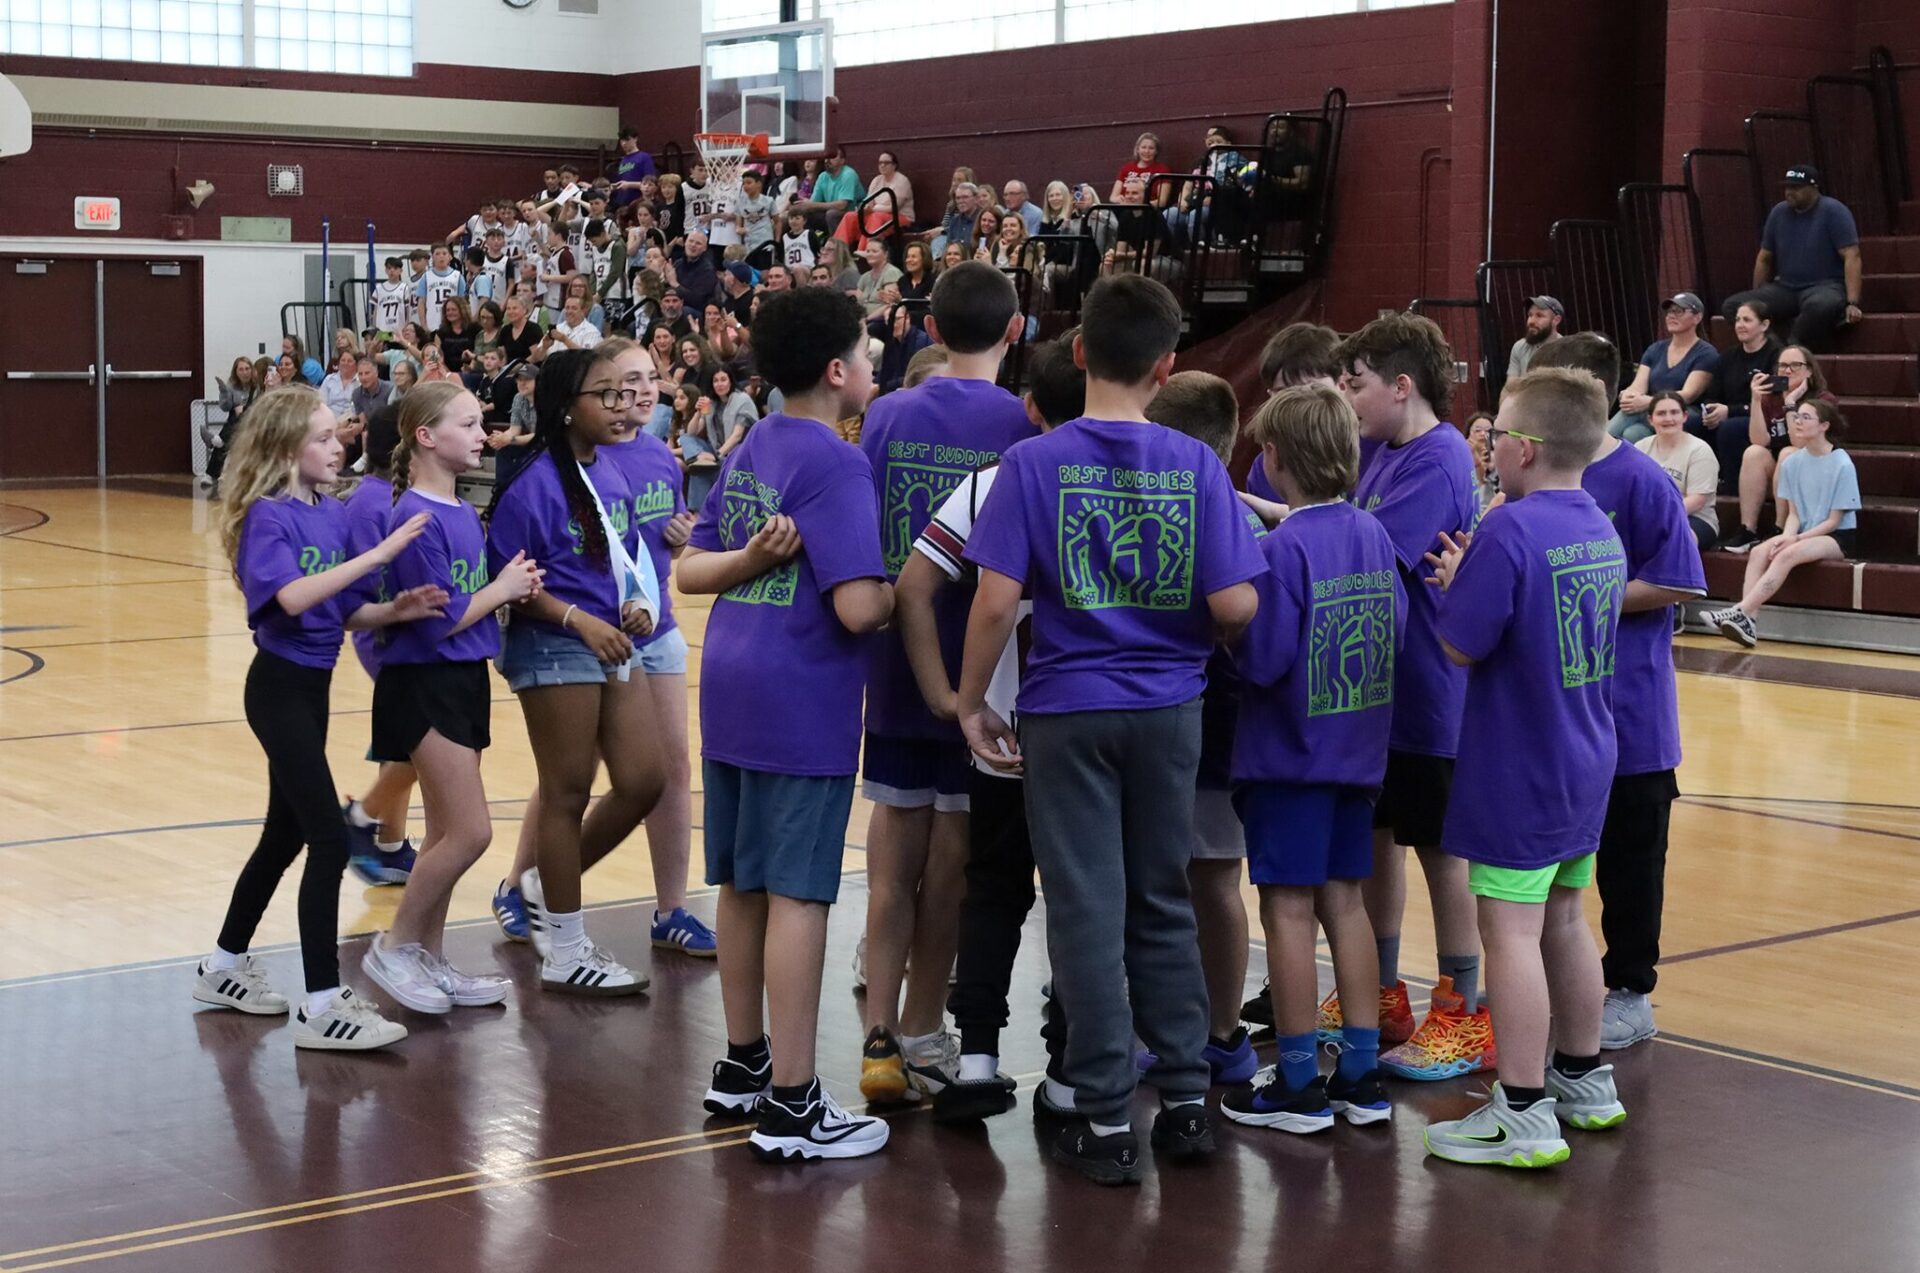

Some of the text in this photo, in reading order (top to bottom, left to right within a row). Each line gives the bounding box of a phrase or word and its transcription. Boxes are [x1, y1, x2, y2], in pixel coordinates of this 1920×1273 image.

[89, 206, 111, 221] EXIT
[693, 201, 708, 216] 81
[435, 289, 451, 304] 15
[383, 303, 399, 317] 77
[888, 441, 1002, 467] BEST BUDDIE
[1058, 464, 1195, 490] BEST BUDDIES
[1546, 544, 1584, 567] BEST
[1312, 577, 1340, 599] BEST
